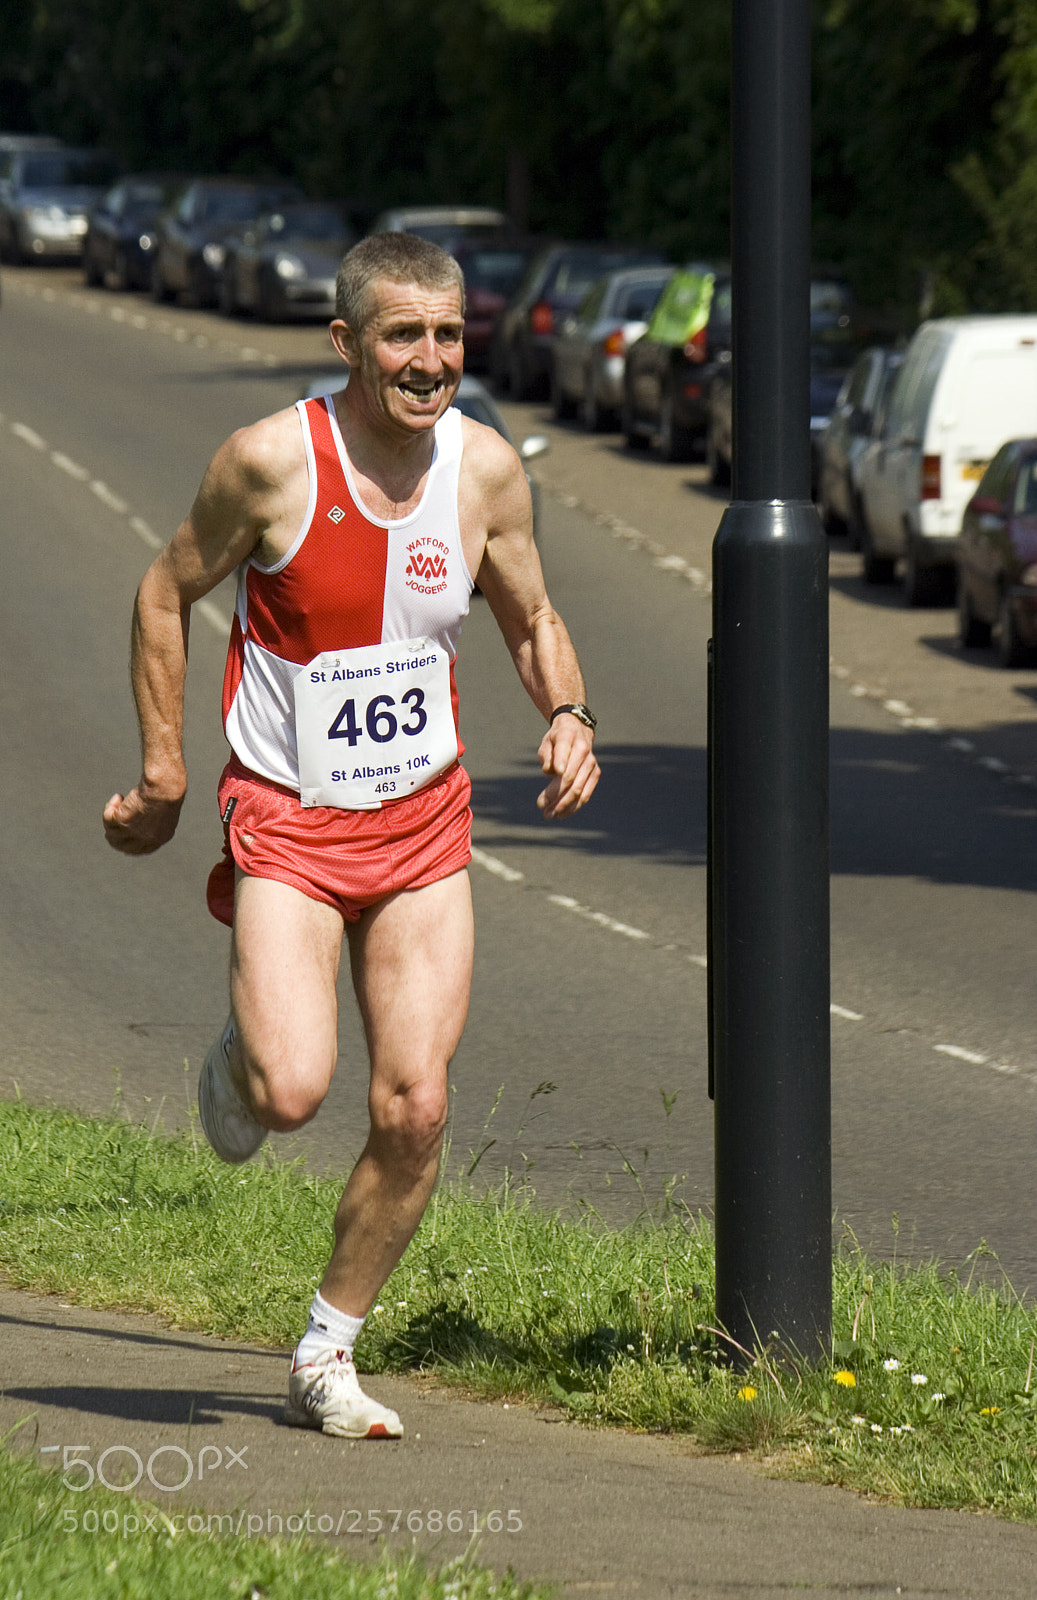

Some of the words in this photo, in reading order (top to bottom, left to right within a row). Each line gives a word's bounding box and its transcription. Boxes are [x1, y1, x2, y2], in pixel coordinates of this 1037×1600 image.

[406, 537, 450, 555] WATFORD
[405, 579, 448, 595] JOGGERS
[310, 671, 326, 683] St
[331, 667, 381, 682] Albans
[386, 654, 437, 674] Striders
[327, 687, 428, 747] 463
[331, 769, 347, 782] St
[352, 764, 401, 780] Albans
[406, 754, 431, 771] 10K
[374, 781, 397, 794] 463
